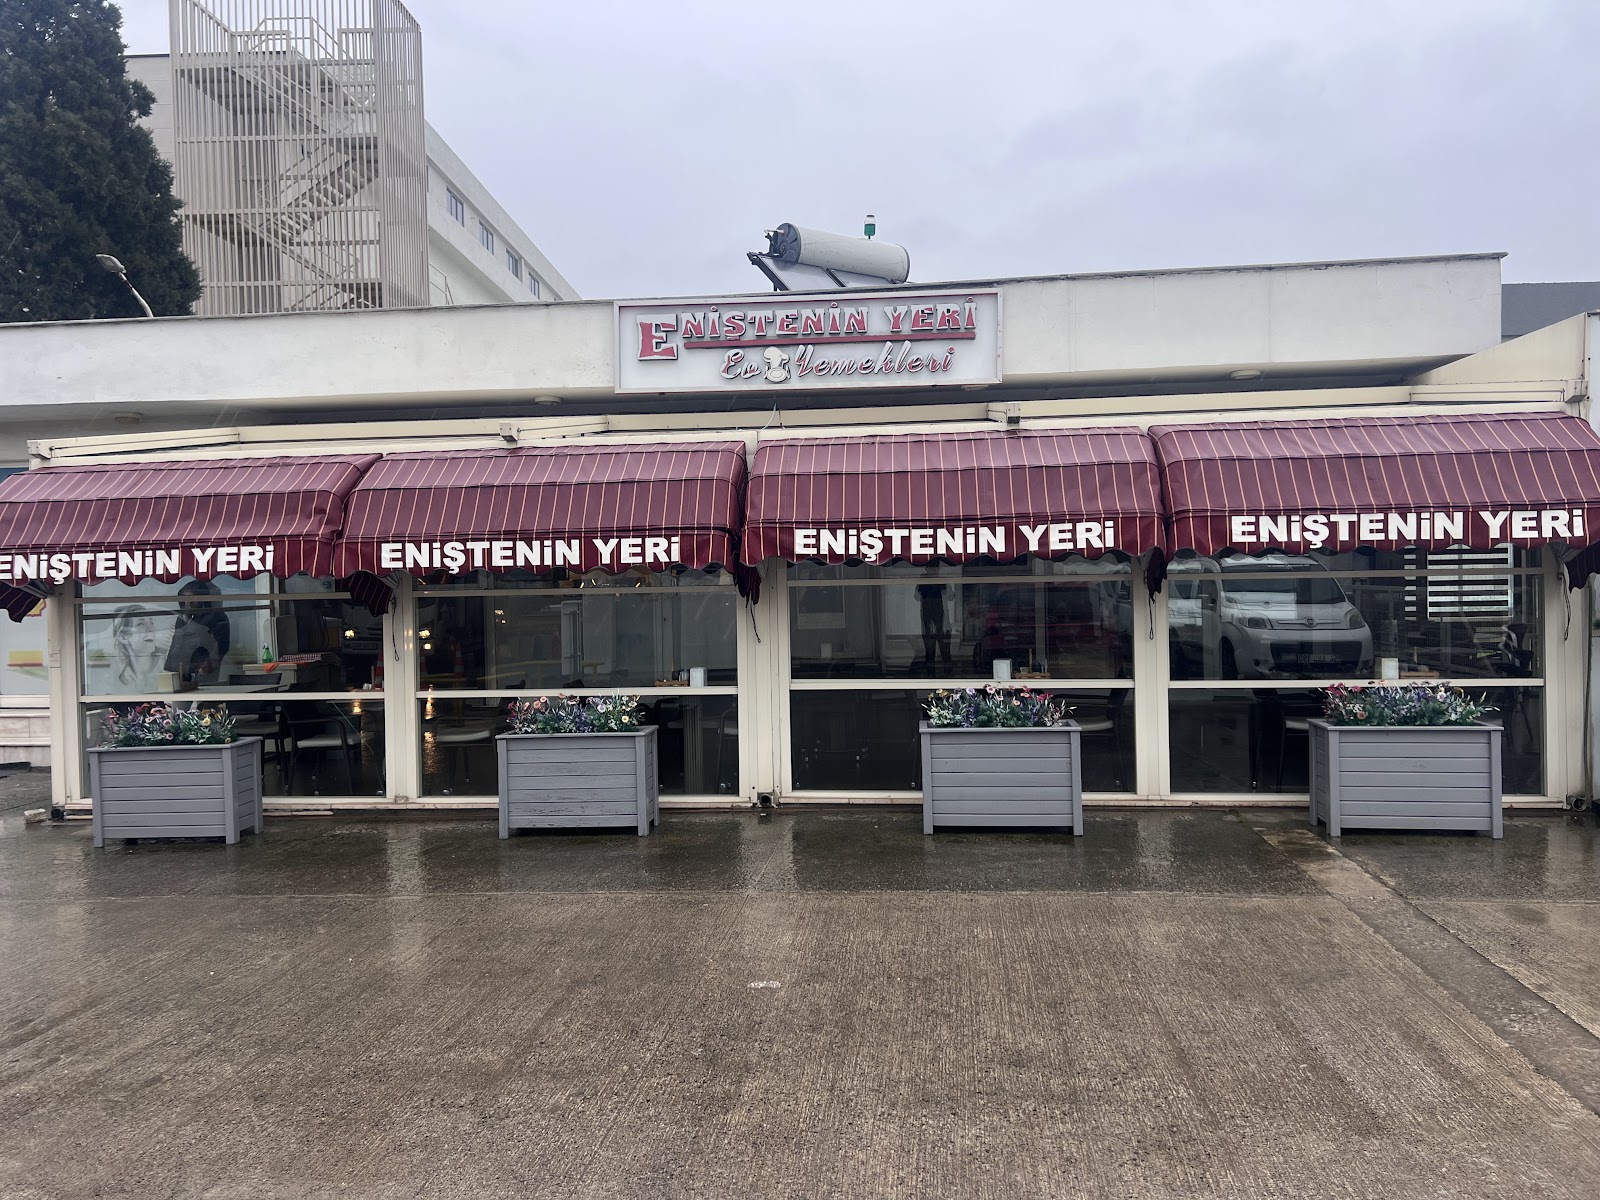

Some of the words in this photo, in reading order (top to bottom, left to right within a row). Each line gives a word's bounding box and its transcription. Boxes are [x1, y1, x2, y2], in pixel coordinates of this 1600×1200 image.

[636, 302, 869, 360] ENİŞTENİN
[884, 296, 977, 332] YERİ
[720, 349, 761, 378] Ev
[795, 340, 955, 377] Yemekleri
